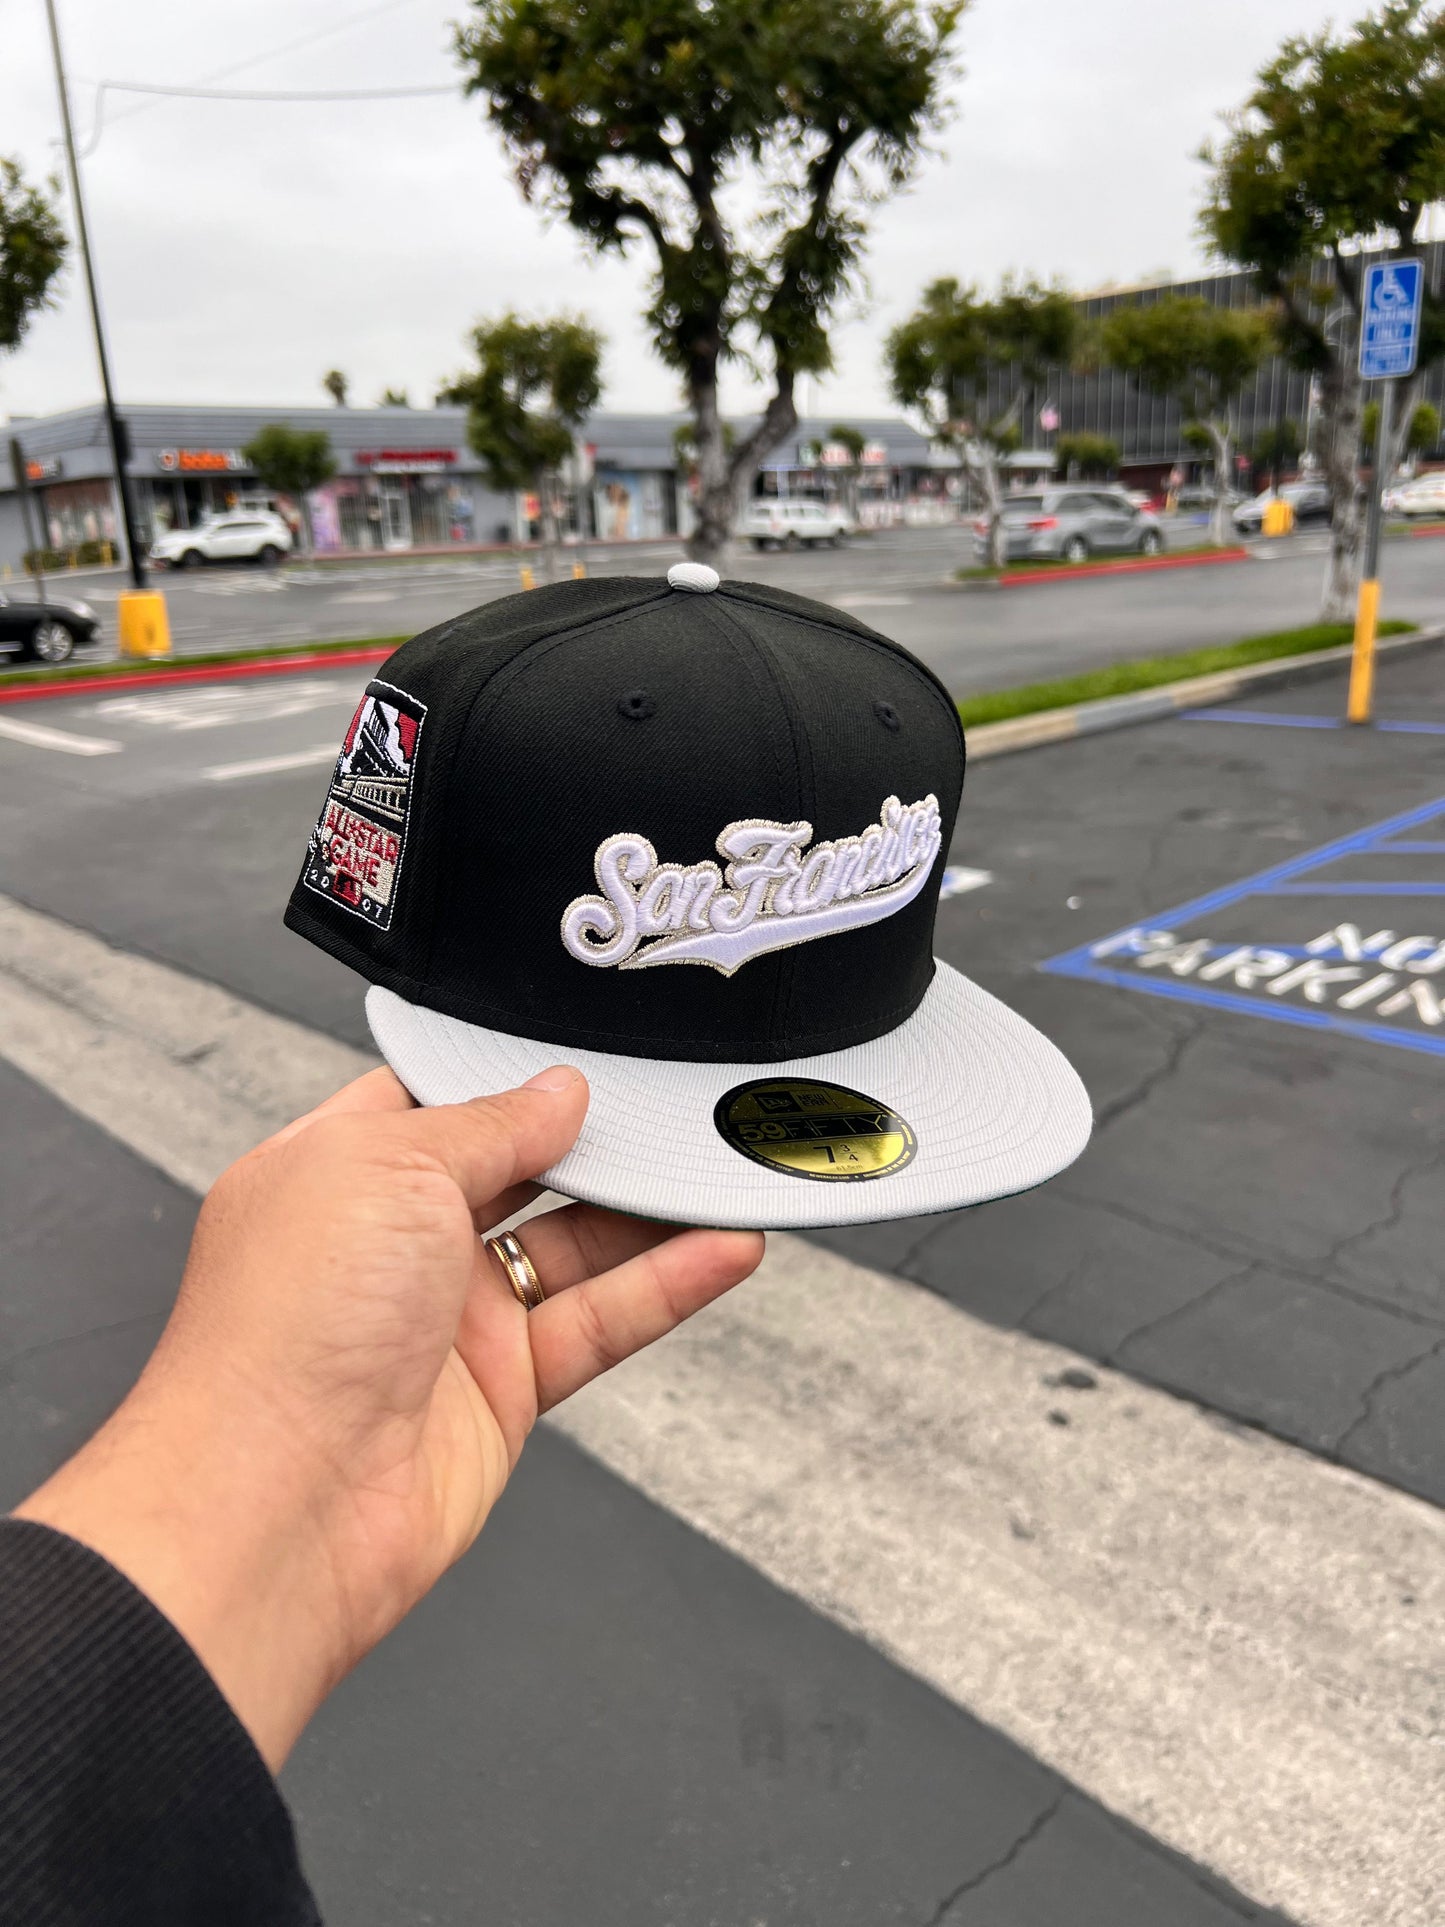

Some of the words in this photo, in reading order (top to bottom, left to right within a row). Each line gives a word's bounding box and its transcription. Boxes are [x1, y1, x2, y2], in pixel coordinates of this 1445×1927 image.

[329, 838, 383, 888] GAME
[560, 832, 722, 968] San
[1305, 922, 1445, 974] NO
[796, 1093, 826, 1101] NEW
[802, 1099, 831, 1107] ERA
[737, 1113, 884, 1142] 59FIFTY
[813, 1145, 836, 1163] 7
